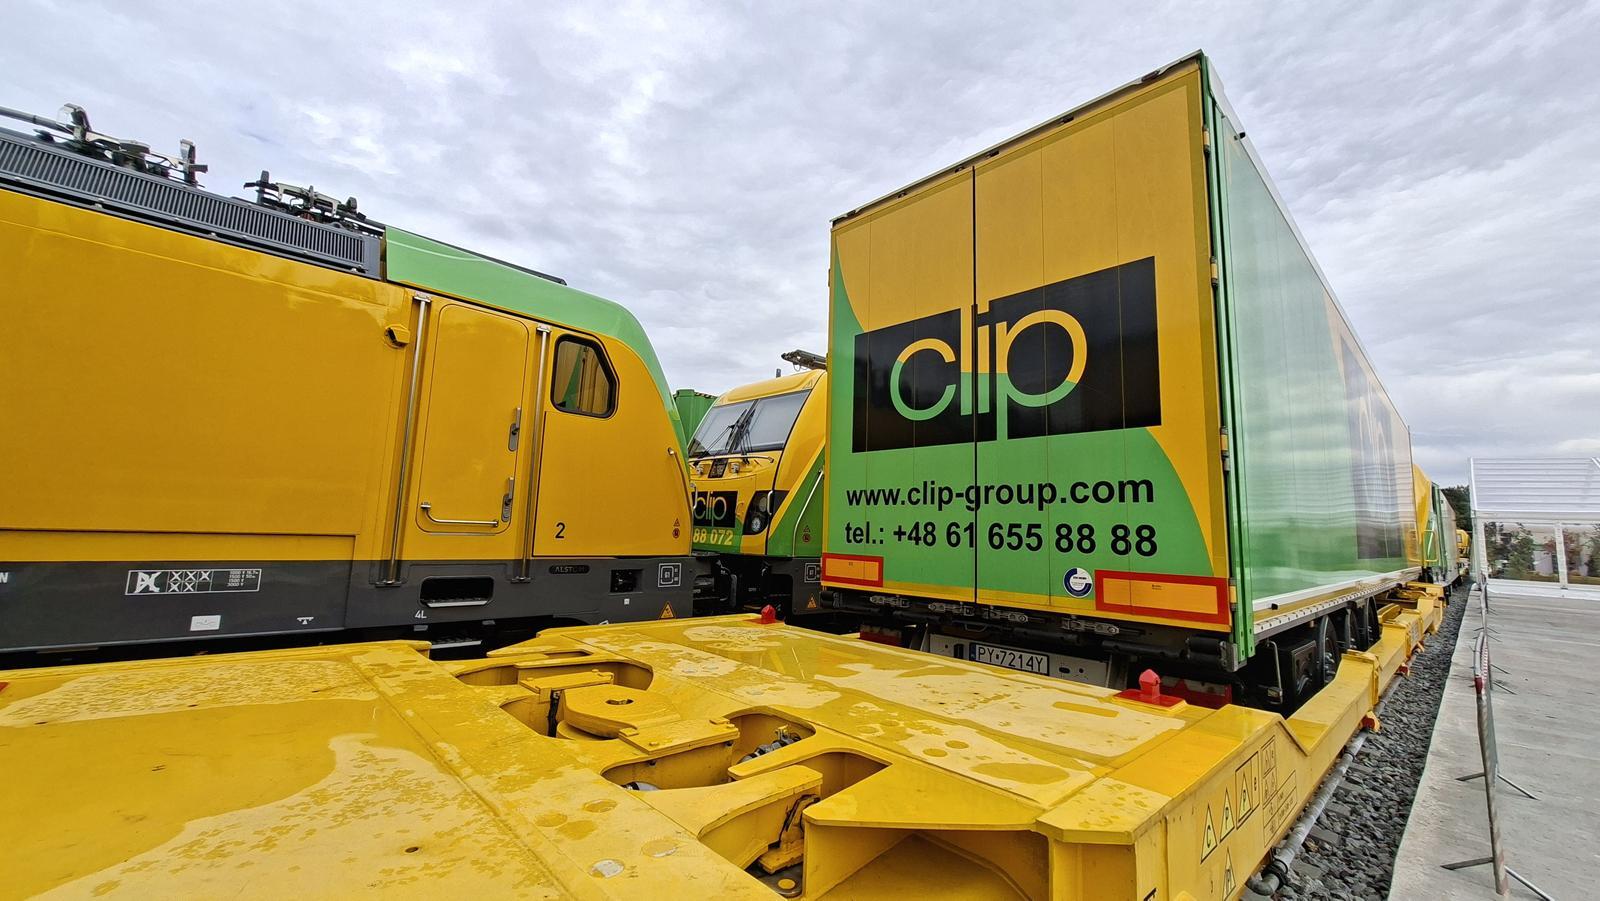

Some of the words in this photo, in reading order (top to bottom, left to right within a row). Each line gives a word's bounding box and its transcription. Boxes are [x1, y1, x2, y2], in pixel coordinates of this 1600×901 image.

[890, 300, 1087, 441] clip
[693, 491, 727, 526] clip
[846, 478, 1154, 512] www.clip-group.com
[555, 522, 565, 539] 2
[710, 529, 734, 545] 072
[845, 521, 885, 545] tel.:
[892, 521, 937, 547] +48
[946, 522, 976, 548] 61
[987, 523, 1043, 552] 655
[1055, 523, 1097, 554] 88
[1110, 524, 1158, 557] 88
[414, 610, 427, 619] 4L
[978, 646, 995, 663] PY
[1000, 650, 1043, 672] 7214Y
